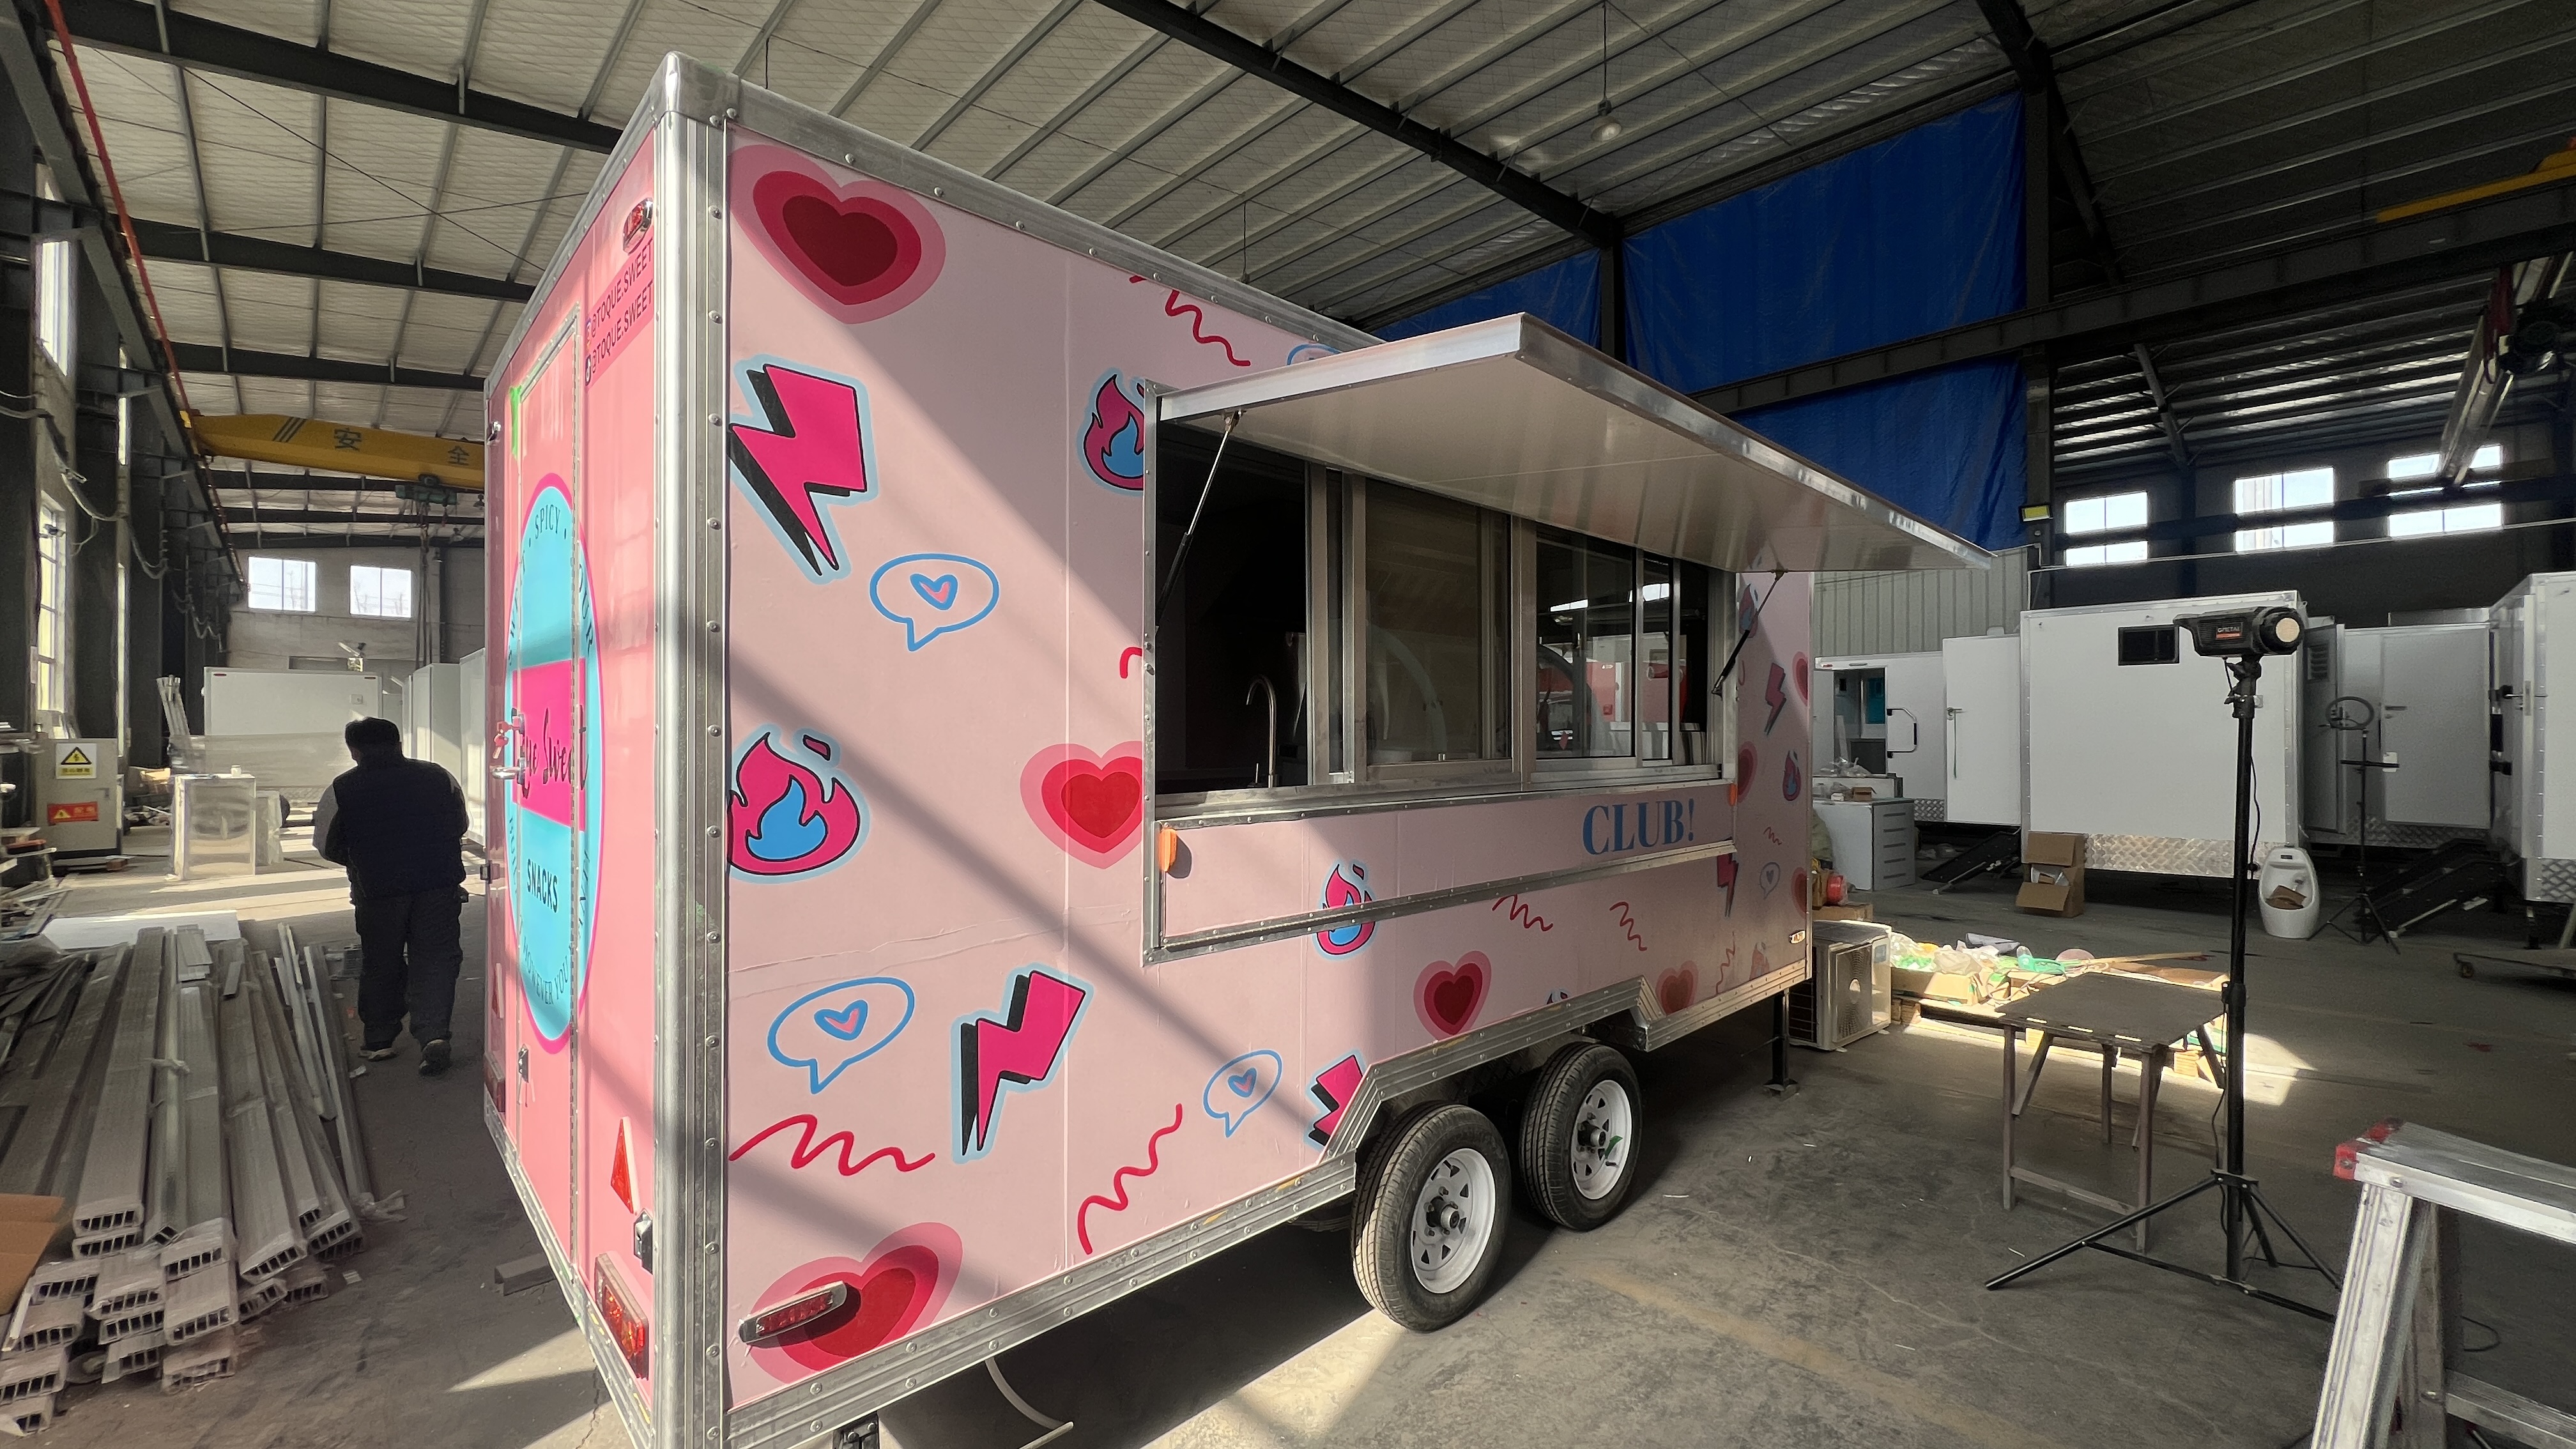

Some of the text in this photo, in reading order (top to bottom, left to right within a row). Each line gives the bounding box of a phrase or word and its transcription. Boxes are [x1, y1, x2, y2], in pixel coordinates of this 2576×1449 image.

[591, 238, 653, 338] @TOQUE.SWEET
[591, 279, 653, 374] @TOQUE.SWEET
[535, 504, 560, 539] SPICY
[571, 557, 594, 657] OUR
[1583, 799, 1694, 855] CLUB!
[527, 859, 558, 913] SNACKS
[523, 935, 554, 1005] HOWEVER
[554, 954, 569, 1000] YOU
